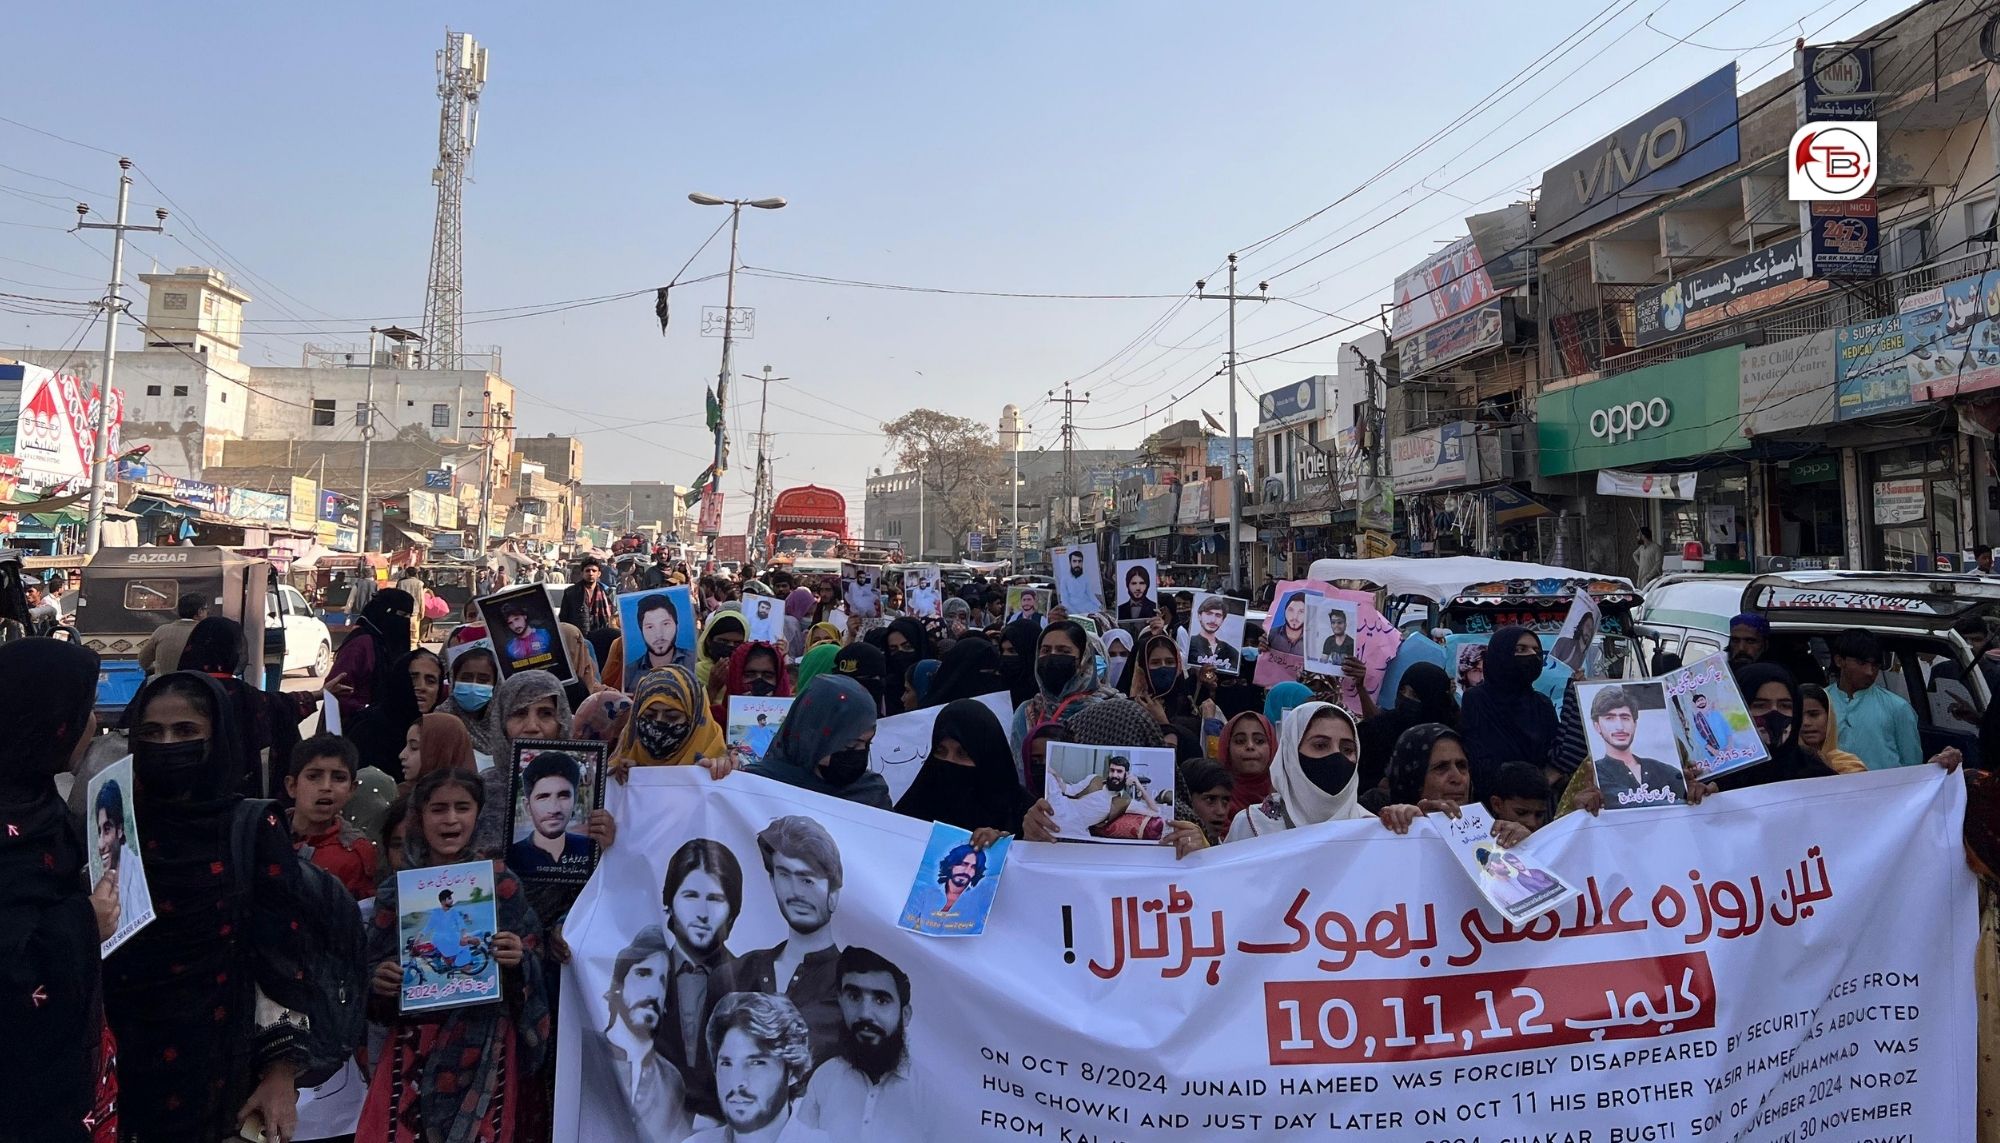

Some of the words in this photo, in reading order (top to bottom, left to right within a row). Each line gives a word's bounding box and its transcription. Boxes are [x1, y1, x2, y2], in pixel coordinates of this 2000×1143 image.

[1573, 117, 1686, 204] vivo
[1850, 203, 1871, 212] NICU
[1638, 307, 1651, 319] CARE
[1853, 323, 1883, 340] SUPER
[1751, 366, 1789, 382] Medical
[1792, 359, 1828, 374] Centre
[1769, 347, 1794, 365] Child
[1797, 344, 1820, 359] Care
[1842, 341, 1873, 359] MEDICAL
[1590, 397, 1670, 443] oppo
[1795, 463, 1830, 477] oppo
[128, 553, 188, 565] SAZGAR
[1651, 869, 1764, 945] روزہ
[1771, 845, 1833, 926] تین
[1088, 884, 1225, 986] ہڑتال
[1237, 888, 1438, 972] بھوک
[407, 983, 439, 999] 2024
[1565, 967, 1700, 1042] کیمپ
[980, 1047, 1009, 1065] ON
[1022, 1055, 1068, 1076] OCT
[1081, 1062, 1167, 1094] 8/2024
[1181, 1079, 1267, 1096] JUNAID
[1280, 1076, 1378, 1096] HAMEED
[1393, 1070, 1442, 1090] WAS
[1455, 1057, 1557, 1084] FORCIBLY
[1571, 1040, 1717, 1072] DISAPPEARED
[1727, 1032, 1743, 1053] BY
[1747, 1007, 1820, 1042] SECURITY
[1864, 972, 1919, 989] FROM
[1278, 987, 1553, 1057] 10,11,12
[981, 1109, 1044, 1136] FROM
[1611, 1122, 1675, 1143] BUGTI
[1691, 1110, 1723, 1136] SON
[1730, 1098, 1748, 1118] OF
[1782, 1042, 1859, 1084] MUHAMMAD
[1874, 1037, 1919, 1054] WAS
[983, 1075, 1025, 1098] HUB
[1035, 1091, 1128, 1124] CHOWKI
[1140, 1113, 1190, 1128] AND
[1202, 1114, 1262, 1131] JUST
[1274, 1113, 1317, 1130] DAY
[1330, 1112, 1403, 1130] LATER
[1415, 1107, 1446, 1126] ON
[1457, 1100, 1501, 1122] OCT
[1512, 1091, 1537, 1114] 11
[1551, 1093, 1586, 1112] HIS
[1597, 1081, 1694, 1109] BROTHER
[1704, 1066, 1742, 1095] YASIR
[1747, 1045, 1800, 1077] HAMEE
[1803, 1022, 1824, 1043] AS
[1829, 1005, 1920, 1033] ABDUCTED
[1743, 1094, 1805, 1136] OVEMBER
[1809, 1075, 1843, 1105] 2024
[1850, 1069, 1918, 1090] NOROZ
[1800, 1116, 1816, 1141] 30
[1820, 1101, 1913, 1132] NOVEMBER
